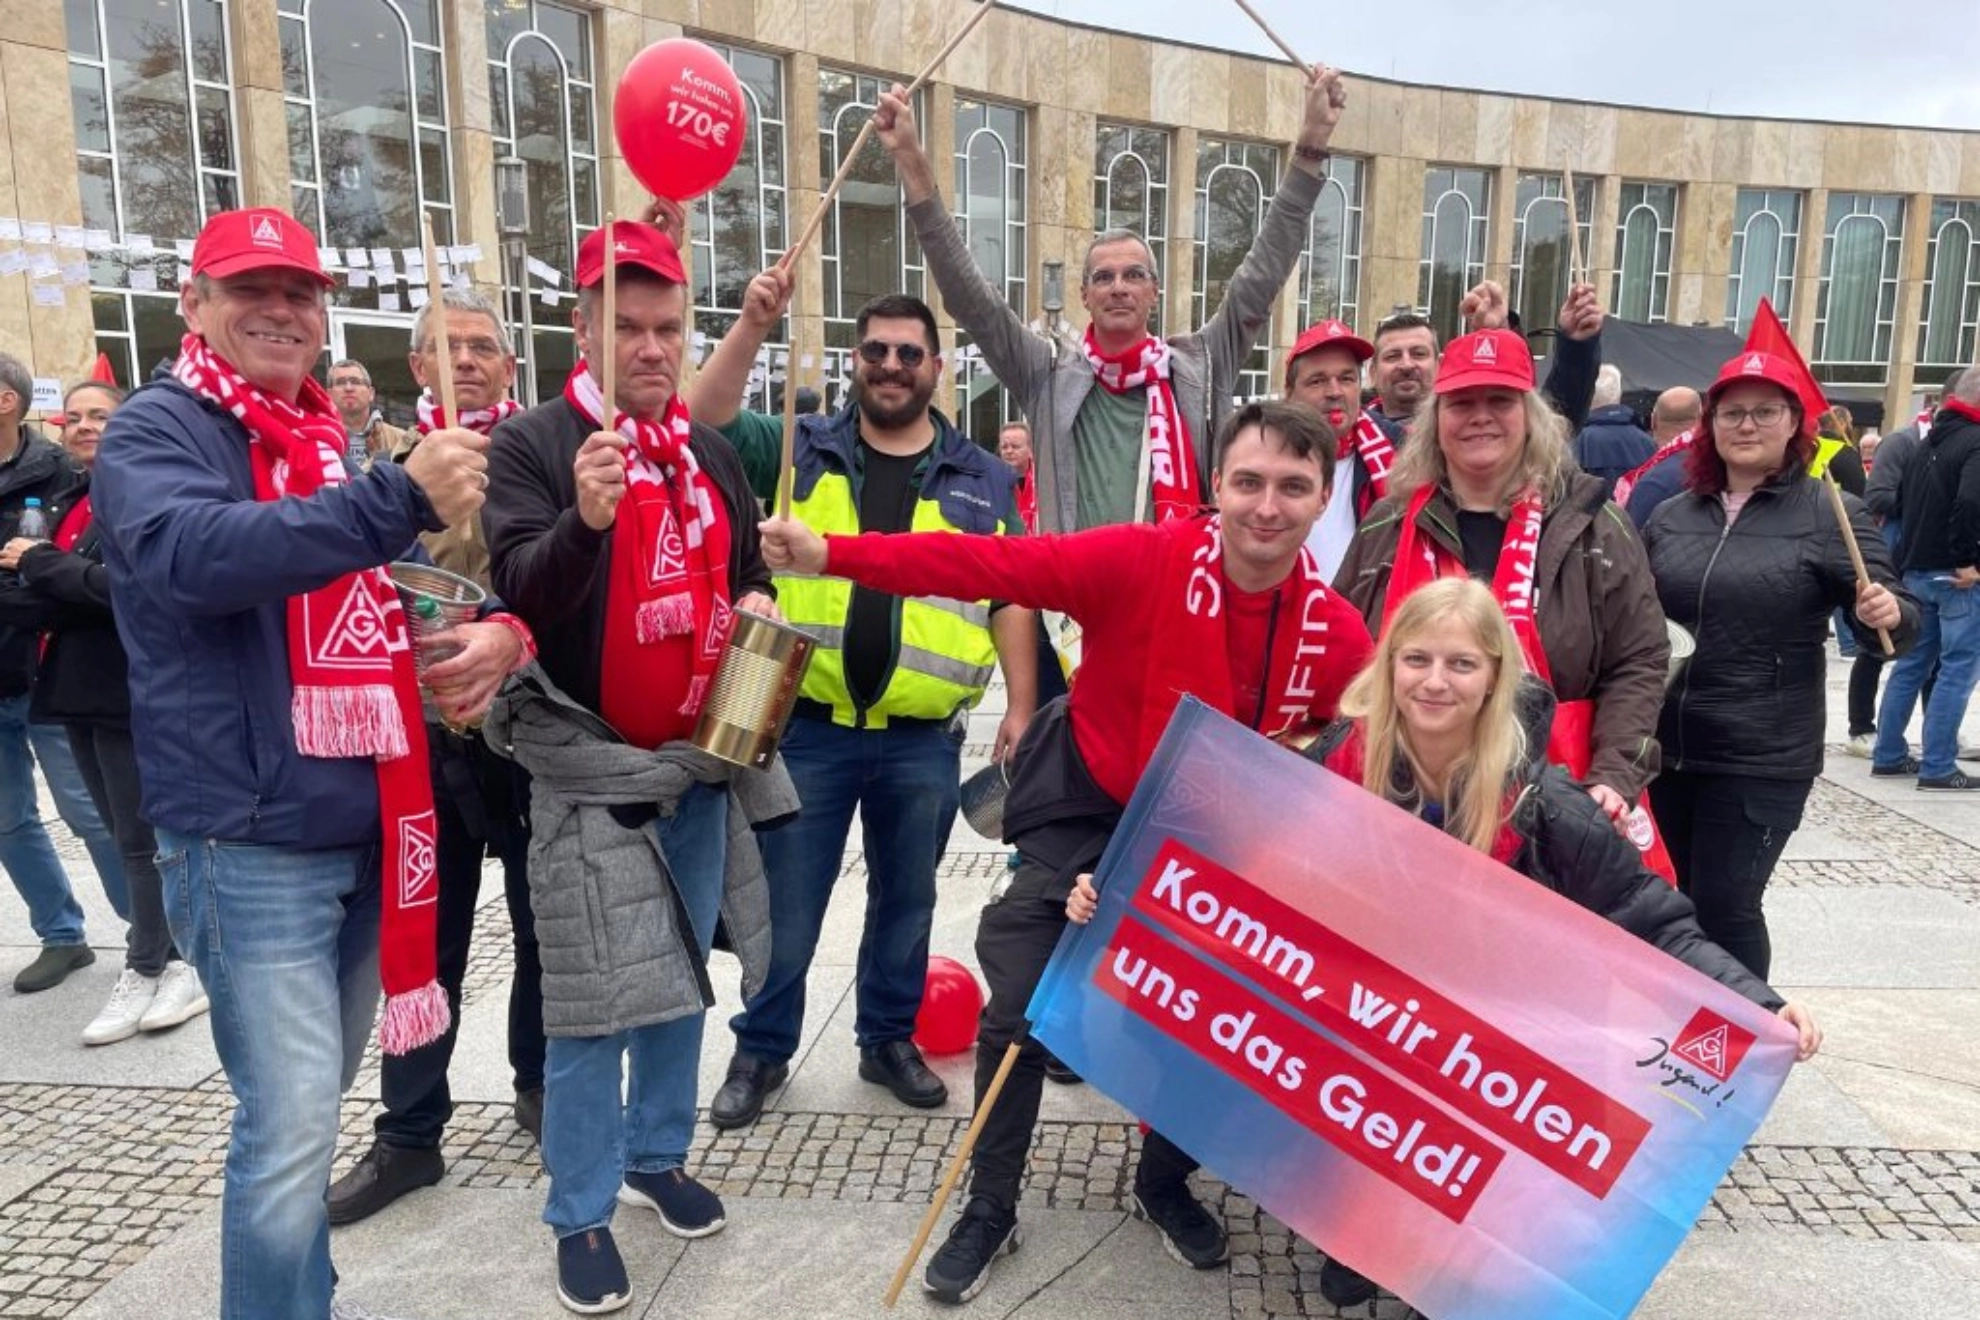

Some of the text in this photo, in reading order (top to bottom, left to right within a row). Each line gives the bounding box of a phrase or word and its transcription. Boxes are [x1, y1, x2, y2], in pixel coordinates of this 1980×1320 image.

[681, 67, 732, 104] Komm,
[666, 101, 730, 147] 170€
[1152, 858, 1612, 1171] Komm, wir holen
[1113, 946, 1482, 1197] uns das Geld!
[1636, 1037, 1735, 1108] Jugend!
